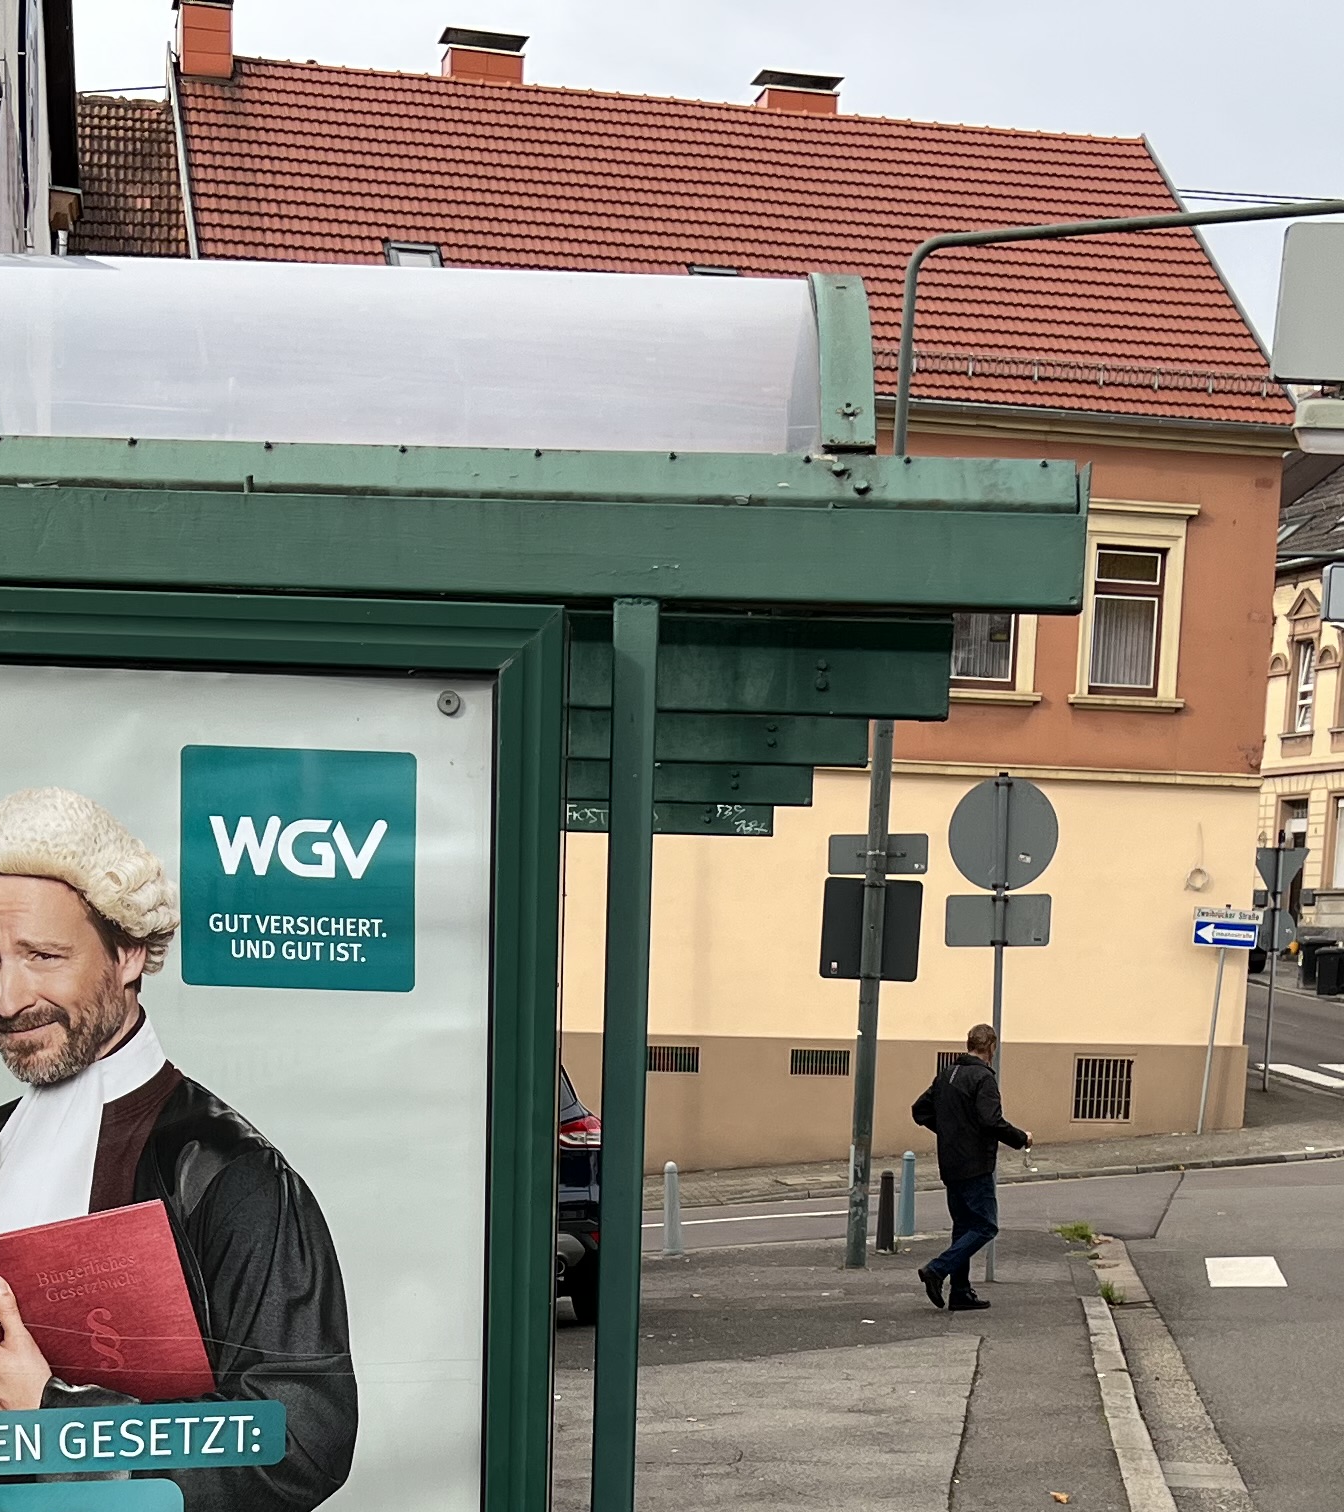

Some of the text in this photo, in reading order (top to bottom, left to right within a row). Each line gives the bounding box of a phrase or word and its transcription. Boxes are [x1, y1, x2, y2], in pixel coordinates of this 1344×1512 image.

[208, 815, 388, 879] WGV
[208, 913, 387, 938] GUT VERSICHERT.
[231, 939, 366, 963] UND GUT IST.
[58, 1414, 262, 1461] GESETZT:
